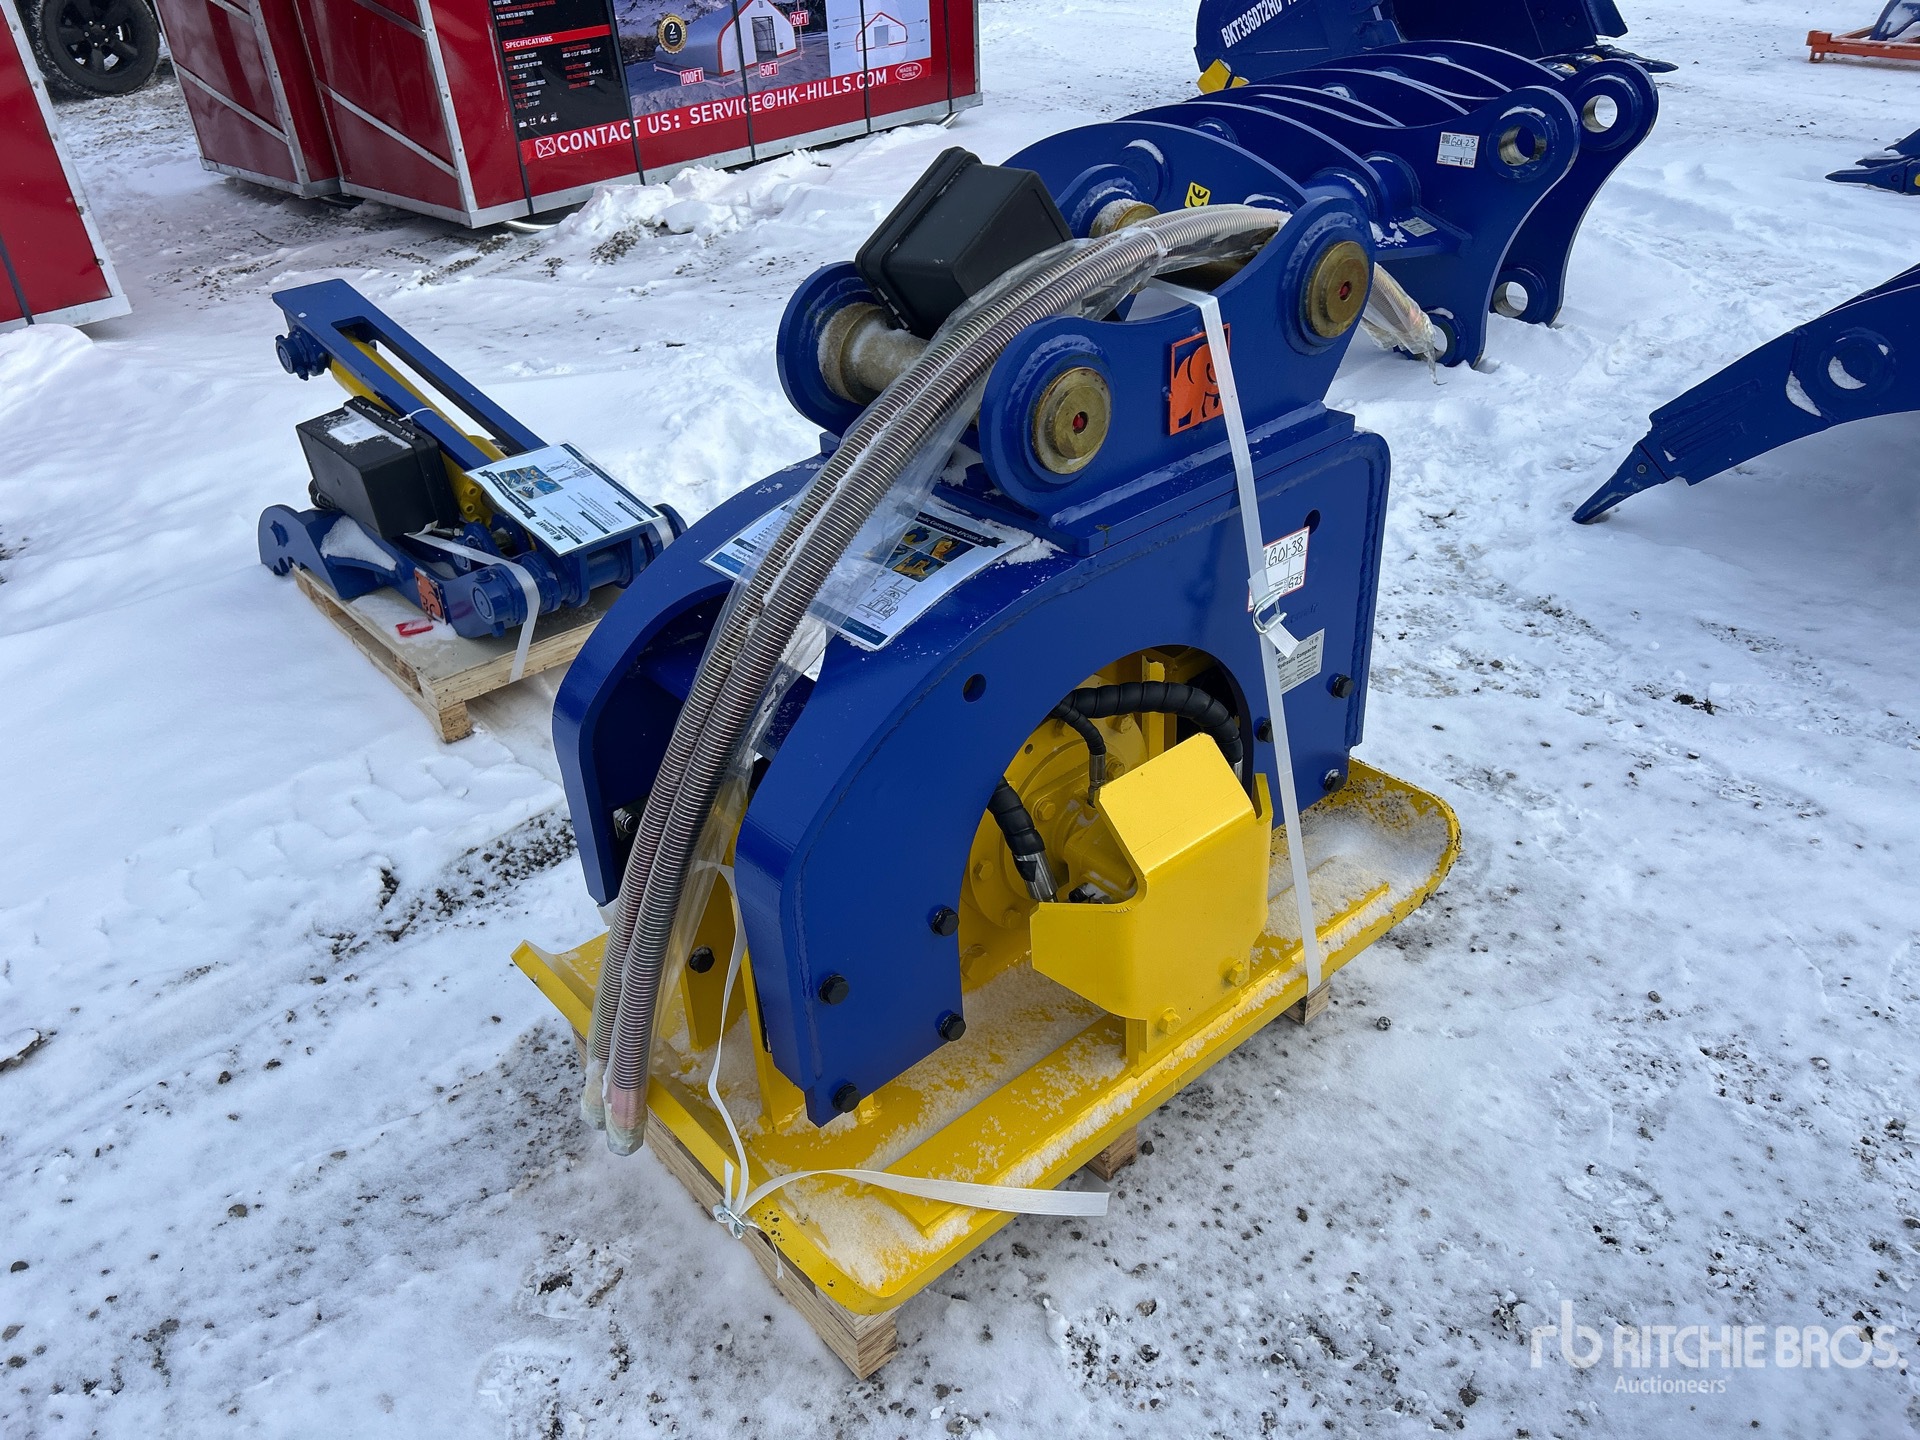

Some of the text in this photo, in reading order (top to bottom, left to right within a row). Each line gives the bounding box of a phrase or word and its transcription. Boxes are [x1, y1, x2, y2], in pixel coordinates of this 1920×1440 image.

[792, 12, 808, 26] 26FT
[669, 23, 676, 35] 2
[505, 35, 553, 49] SPECIFICATIONS
[682, 69, 702, 85] 100FT
[761, 63, 777, 77] 50FT
[557, 119, 641, 153] CONTACT
[689, 69, 887, 124] SERVICE@HK-HILLS.COM
